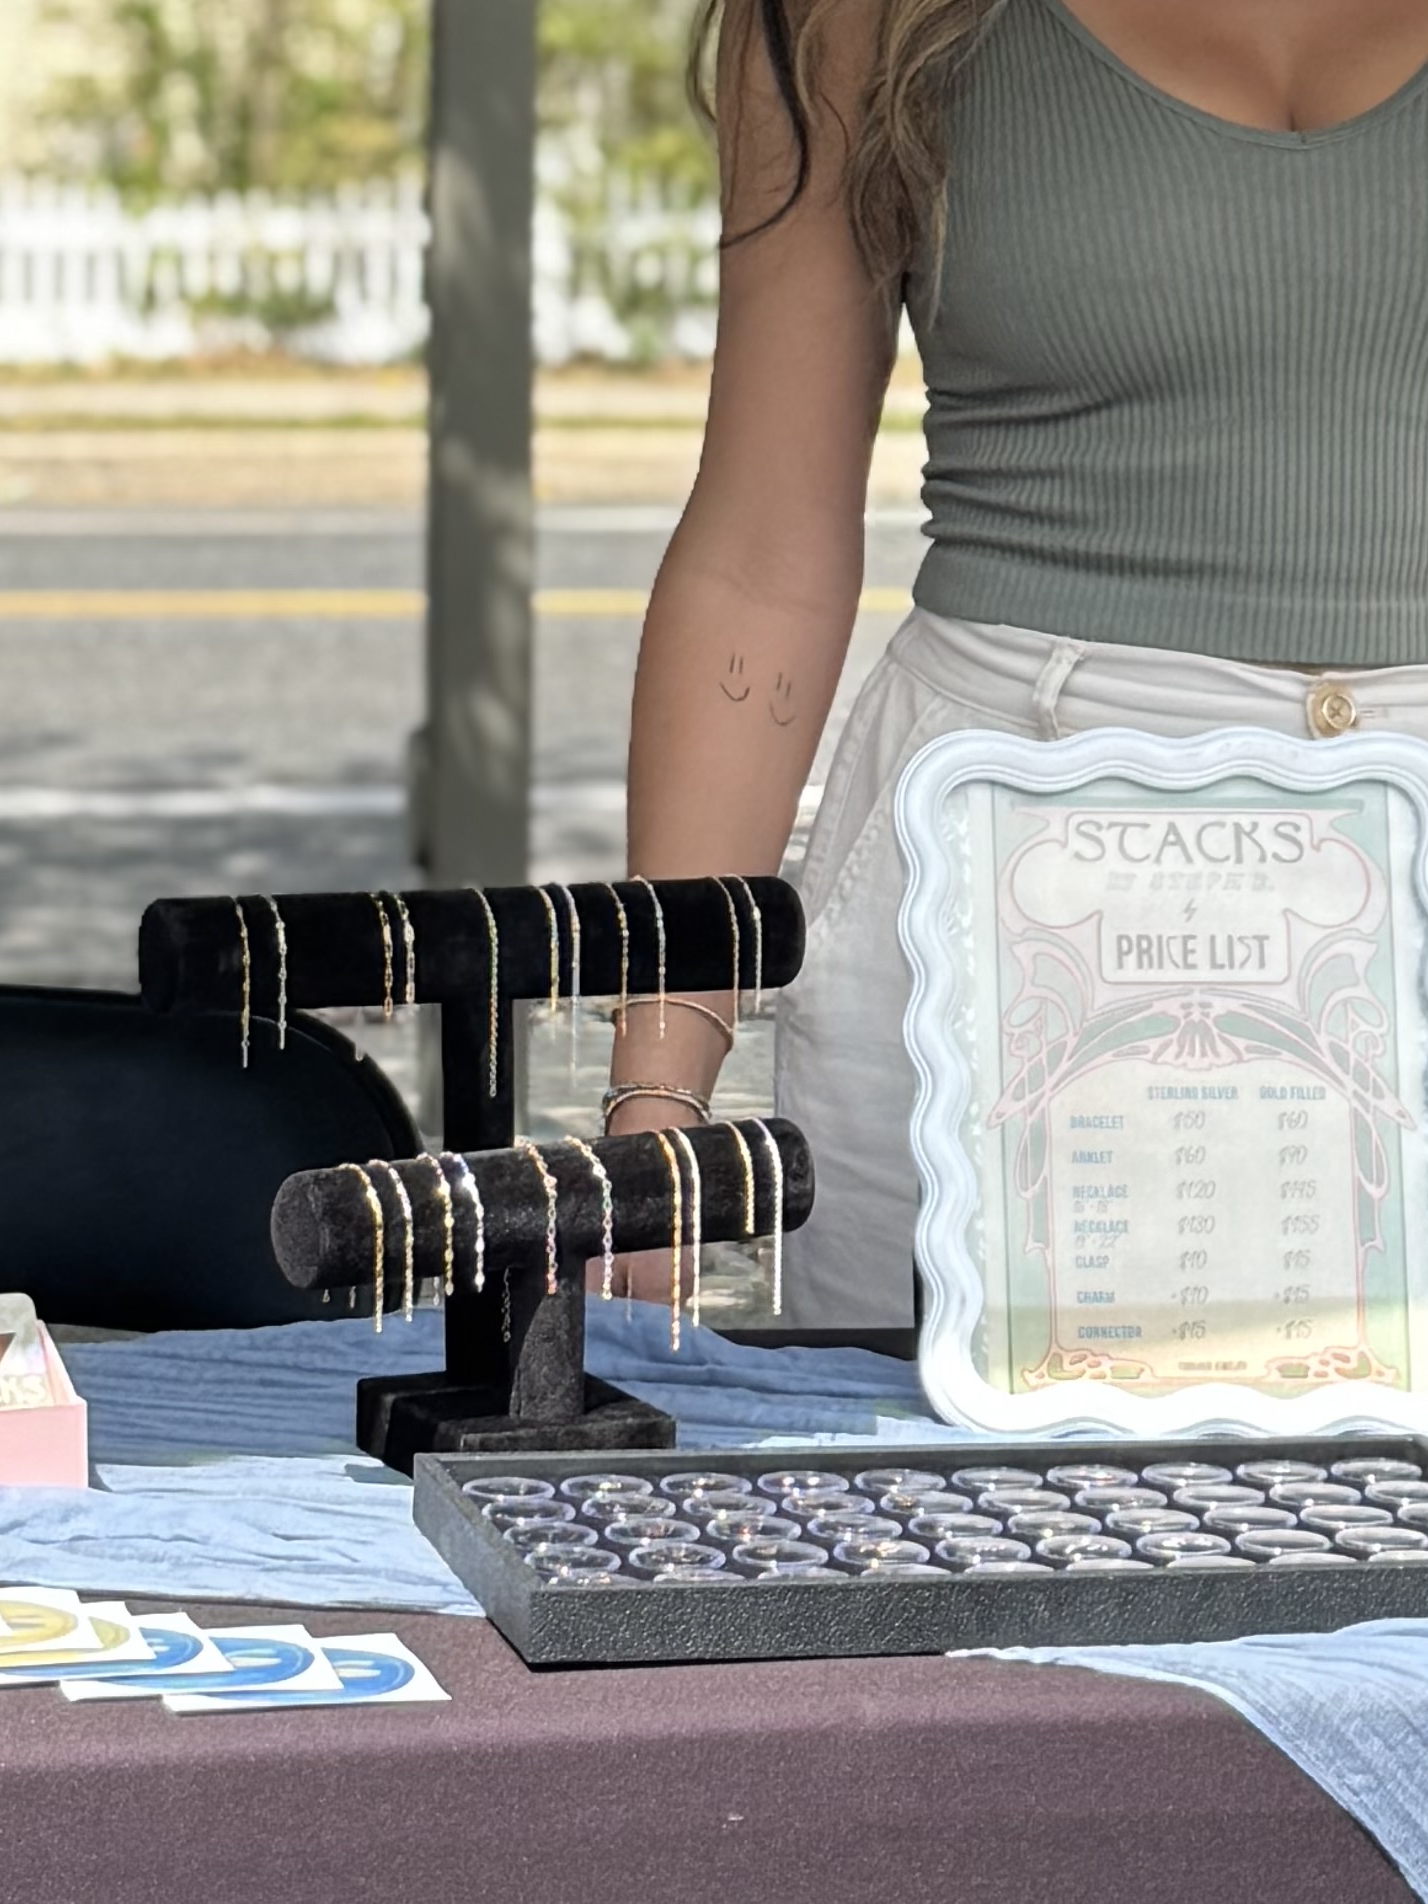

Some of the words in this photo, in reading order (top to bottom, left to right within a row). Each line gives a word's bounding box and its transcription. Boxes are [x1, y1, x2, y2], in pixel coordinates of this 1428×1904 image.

[1072, 819, 1306, 864] STACKS
[1115, 934, 1197, 970] PRICE
[1209, 934, 1270, 970] LIST
[1201, 1086, 1239, 1100] SILVER
[1289, 1085, 1327, 1100] FILLED
[1069, 1115, 1125, 1130] BRACELET
[1174, 1145, 1207, 1166] $60
[1072, 1183, 1129, 1199] NECKLACE
[1176, 1178, 1217, 1200] $120
[1074, 1219, 1129, 1233] NECKLACE
[1075, 1255, 1110, 1269] CLASP
[1076, 1290, 1115, 1304] CHARM
[1077, 1325, 1143, 1339] CONNECTOR
